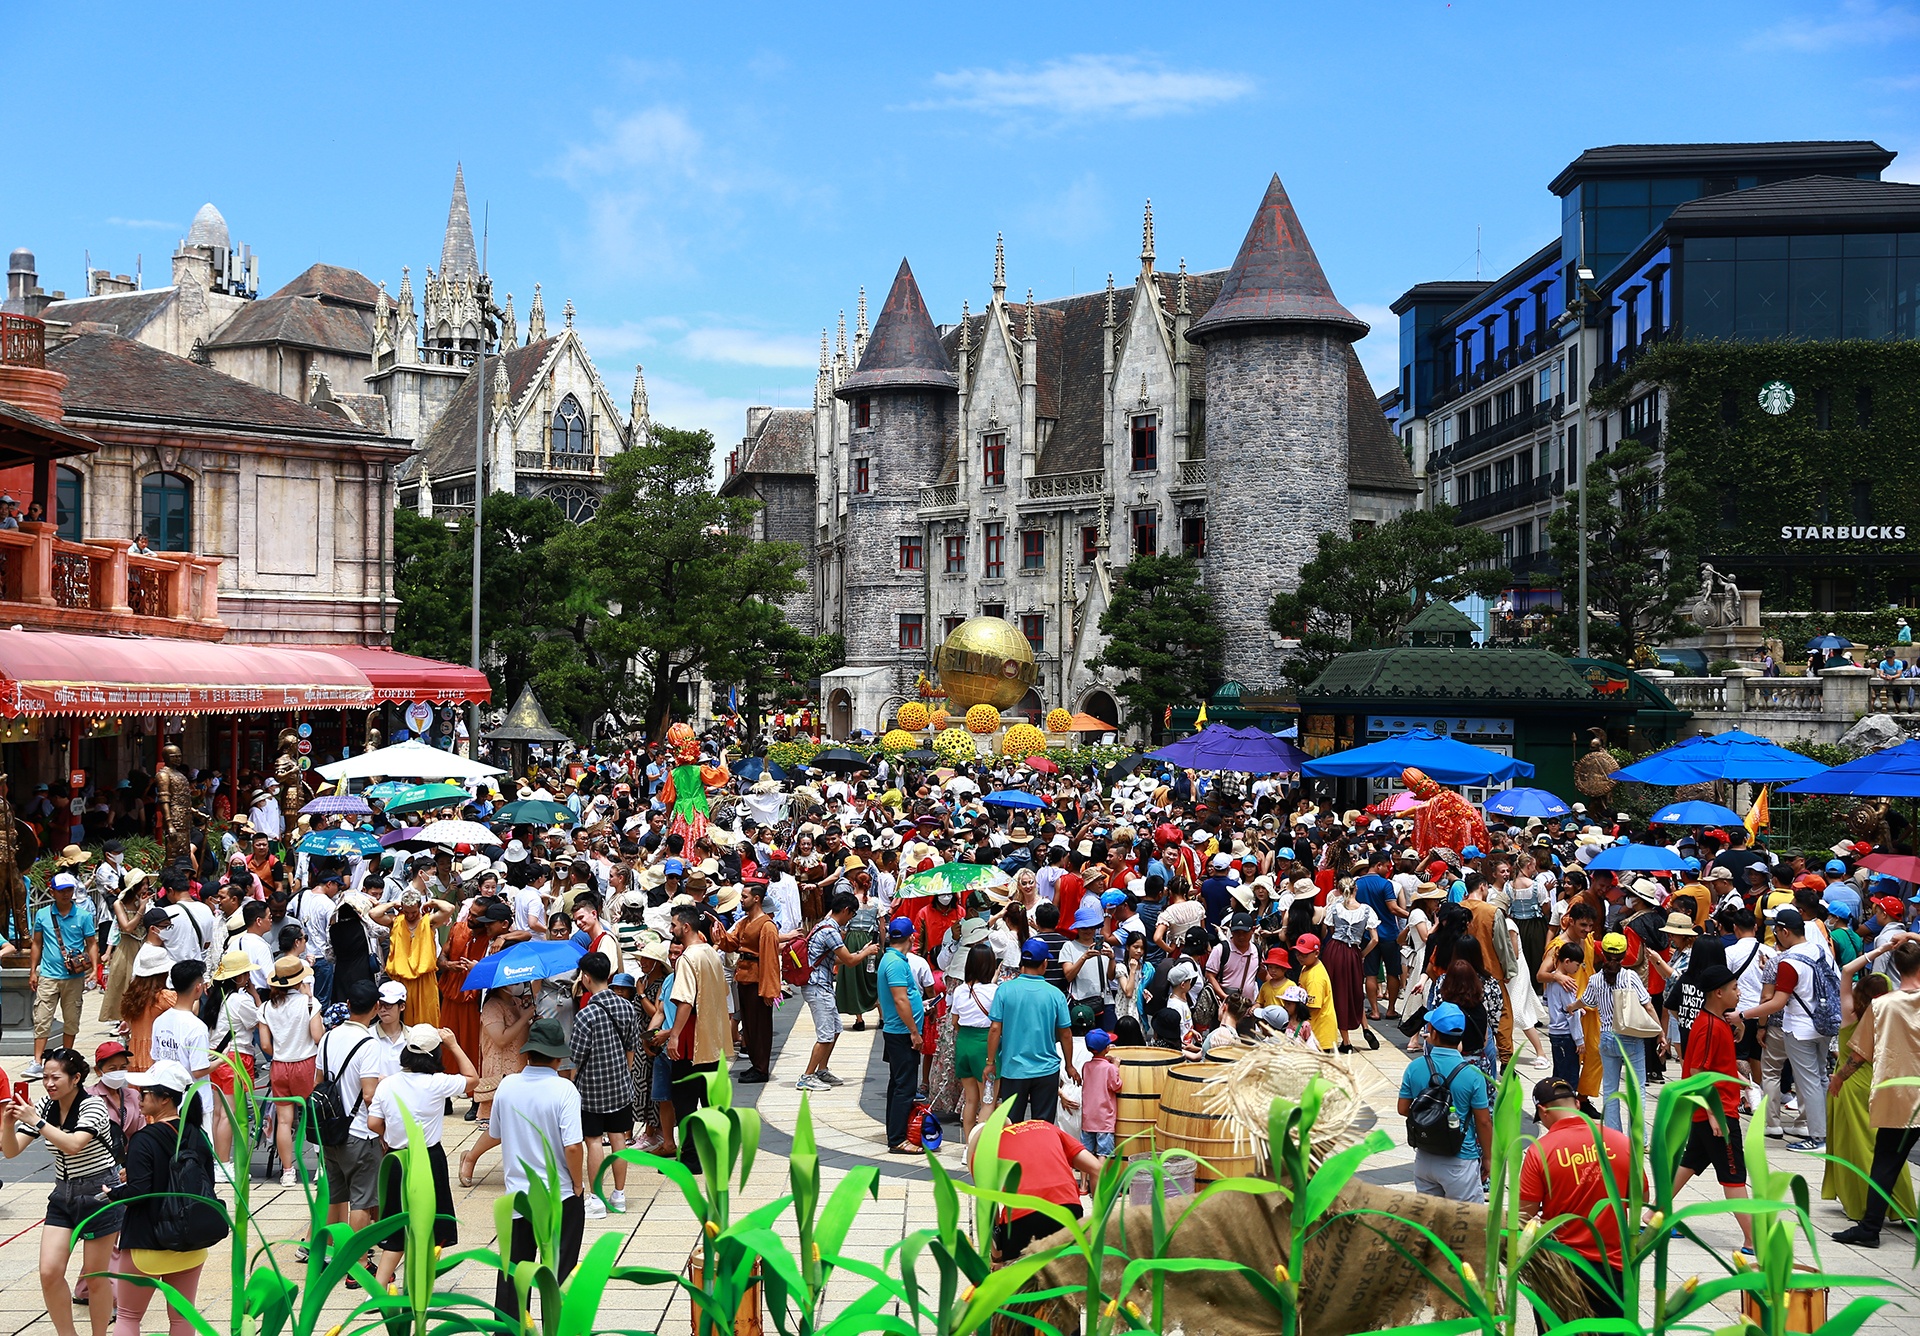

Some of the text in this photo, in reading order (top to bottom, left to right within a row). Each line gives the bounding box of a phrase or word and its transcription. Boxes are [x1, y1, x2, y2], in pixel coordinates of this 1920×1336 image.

[1781, 526, 1906, 539] STARBUCKS
[378, 689, 416, 699] COFFEE
[437, 689, 465, 700] JUICE
[21, 699, 46, 711] FENCHA
[1681, 983, 1696, 996] KIND
[1682, 995, 1705, 1009] NASTY
[1556, 1142, 1616, 1185] Uplift
[1380, 1223, 1411, 1286] CASEW
[1447, 1233, 1466, 1275] CTE
[1347, 1276, 1375, 1312] NOIX
[1363, 1251, 1381, 1273] DE
